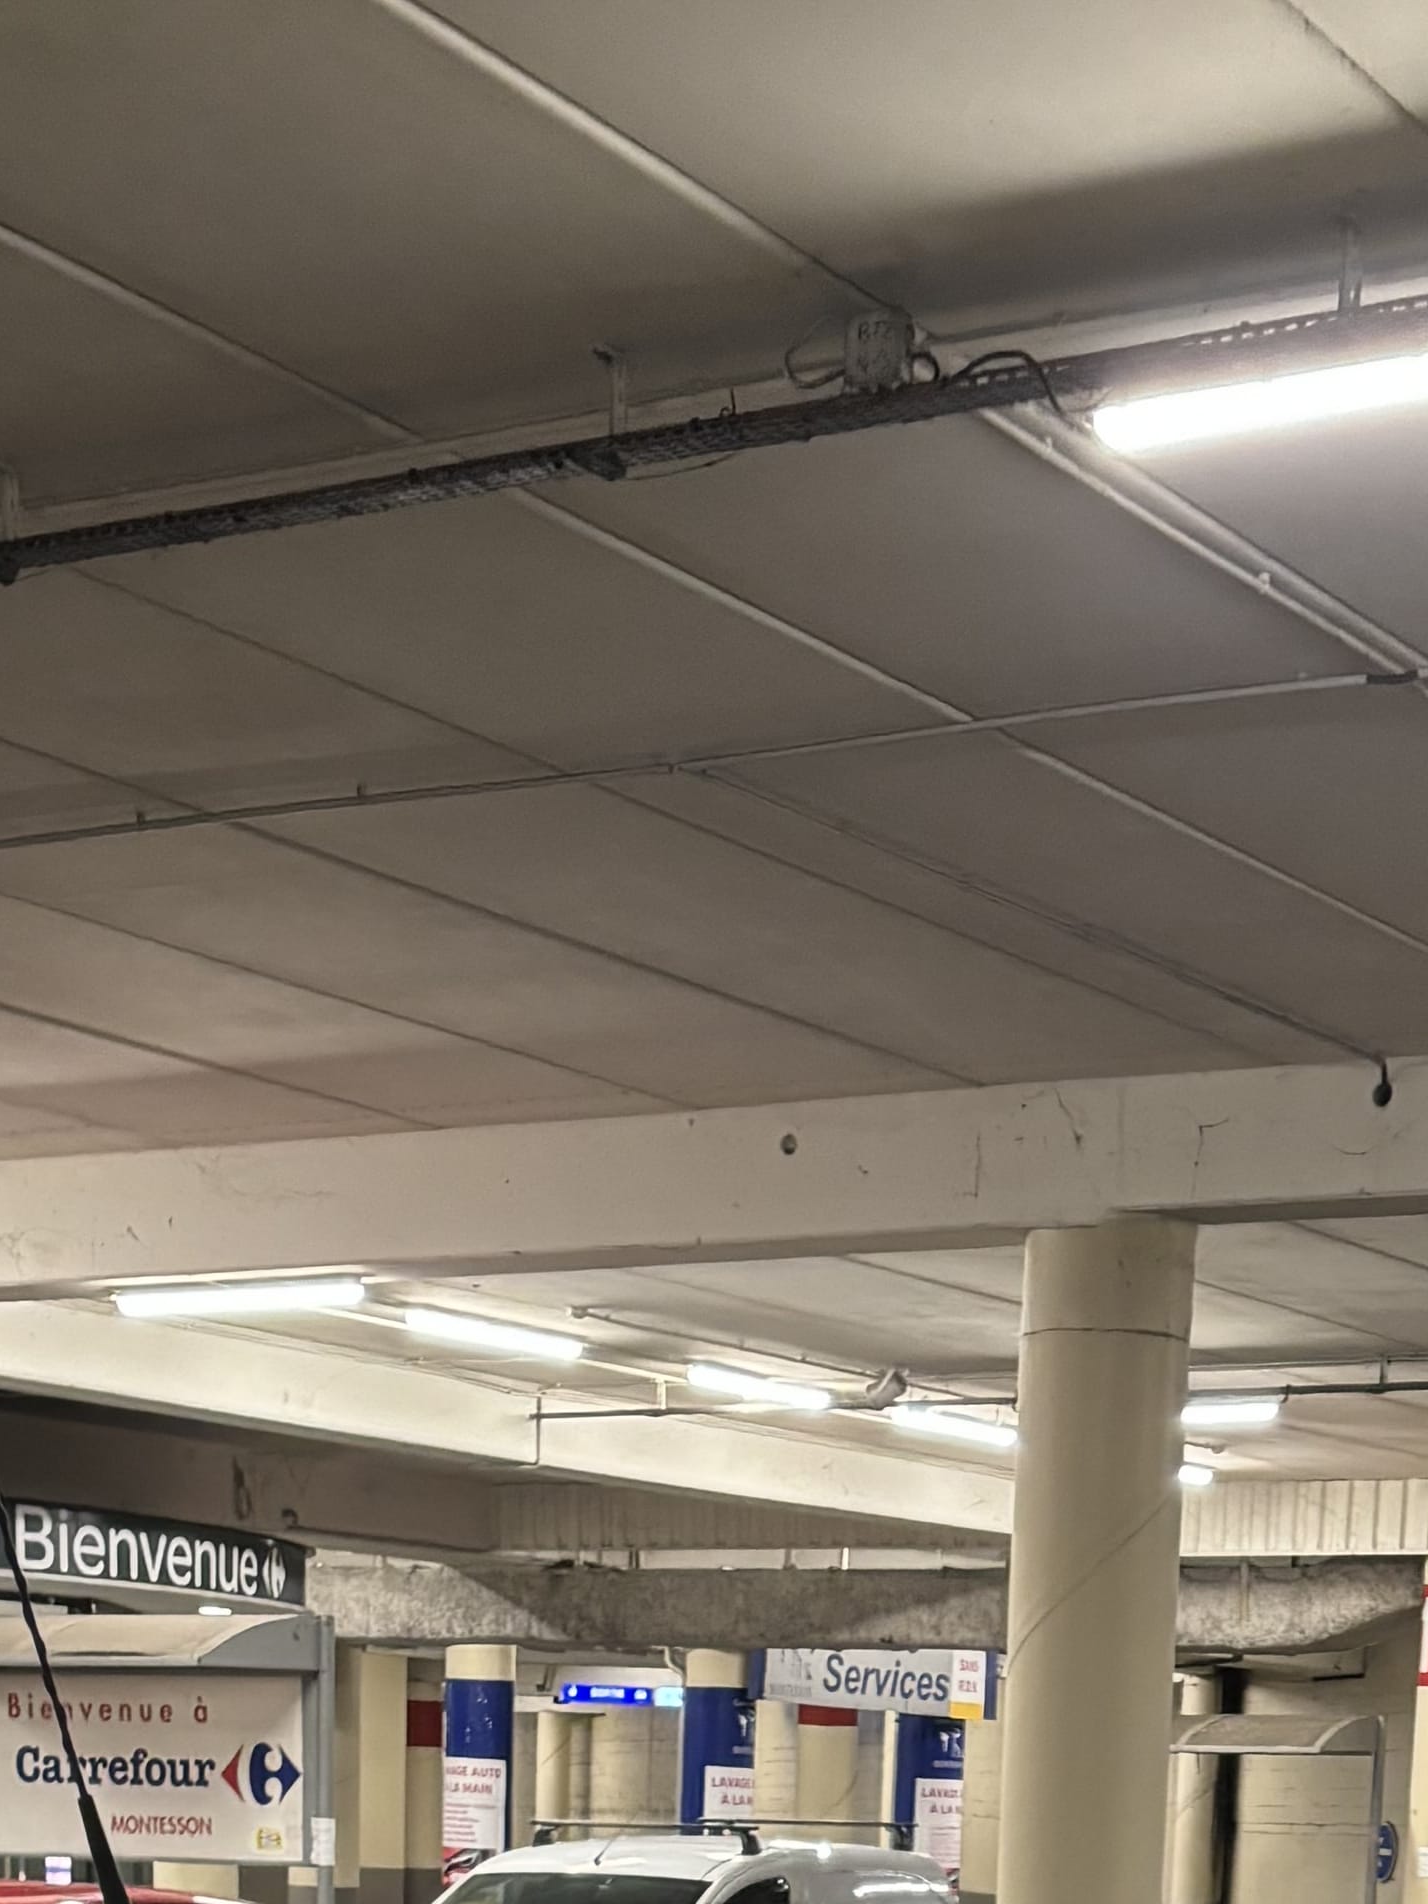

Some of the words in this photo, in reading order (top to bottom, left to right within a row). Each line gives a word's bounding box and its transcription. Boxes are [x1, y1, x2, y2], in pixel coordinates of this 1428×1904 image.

[15, 1504, 259, 1596] Bienvenue
[823, 1653, 951, 1701] Services
[16, 1745, 215, 1787] Carrefour
[111, 1815, 212, 1836] MONTESSON
